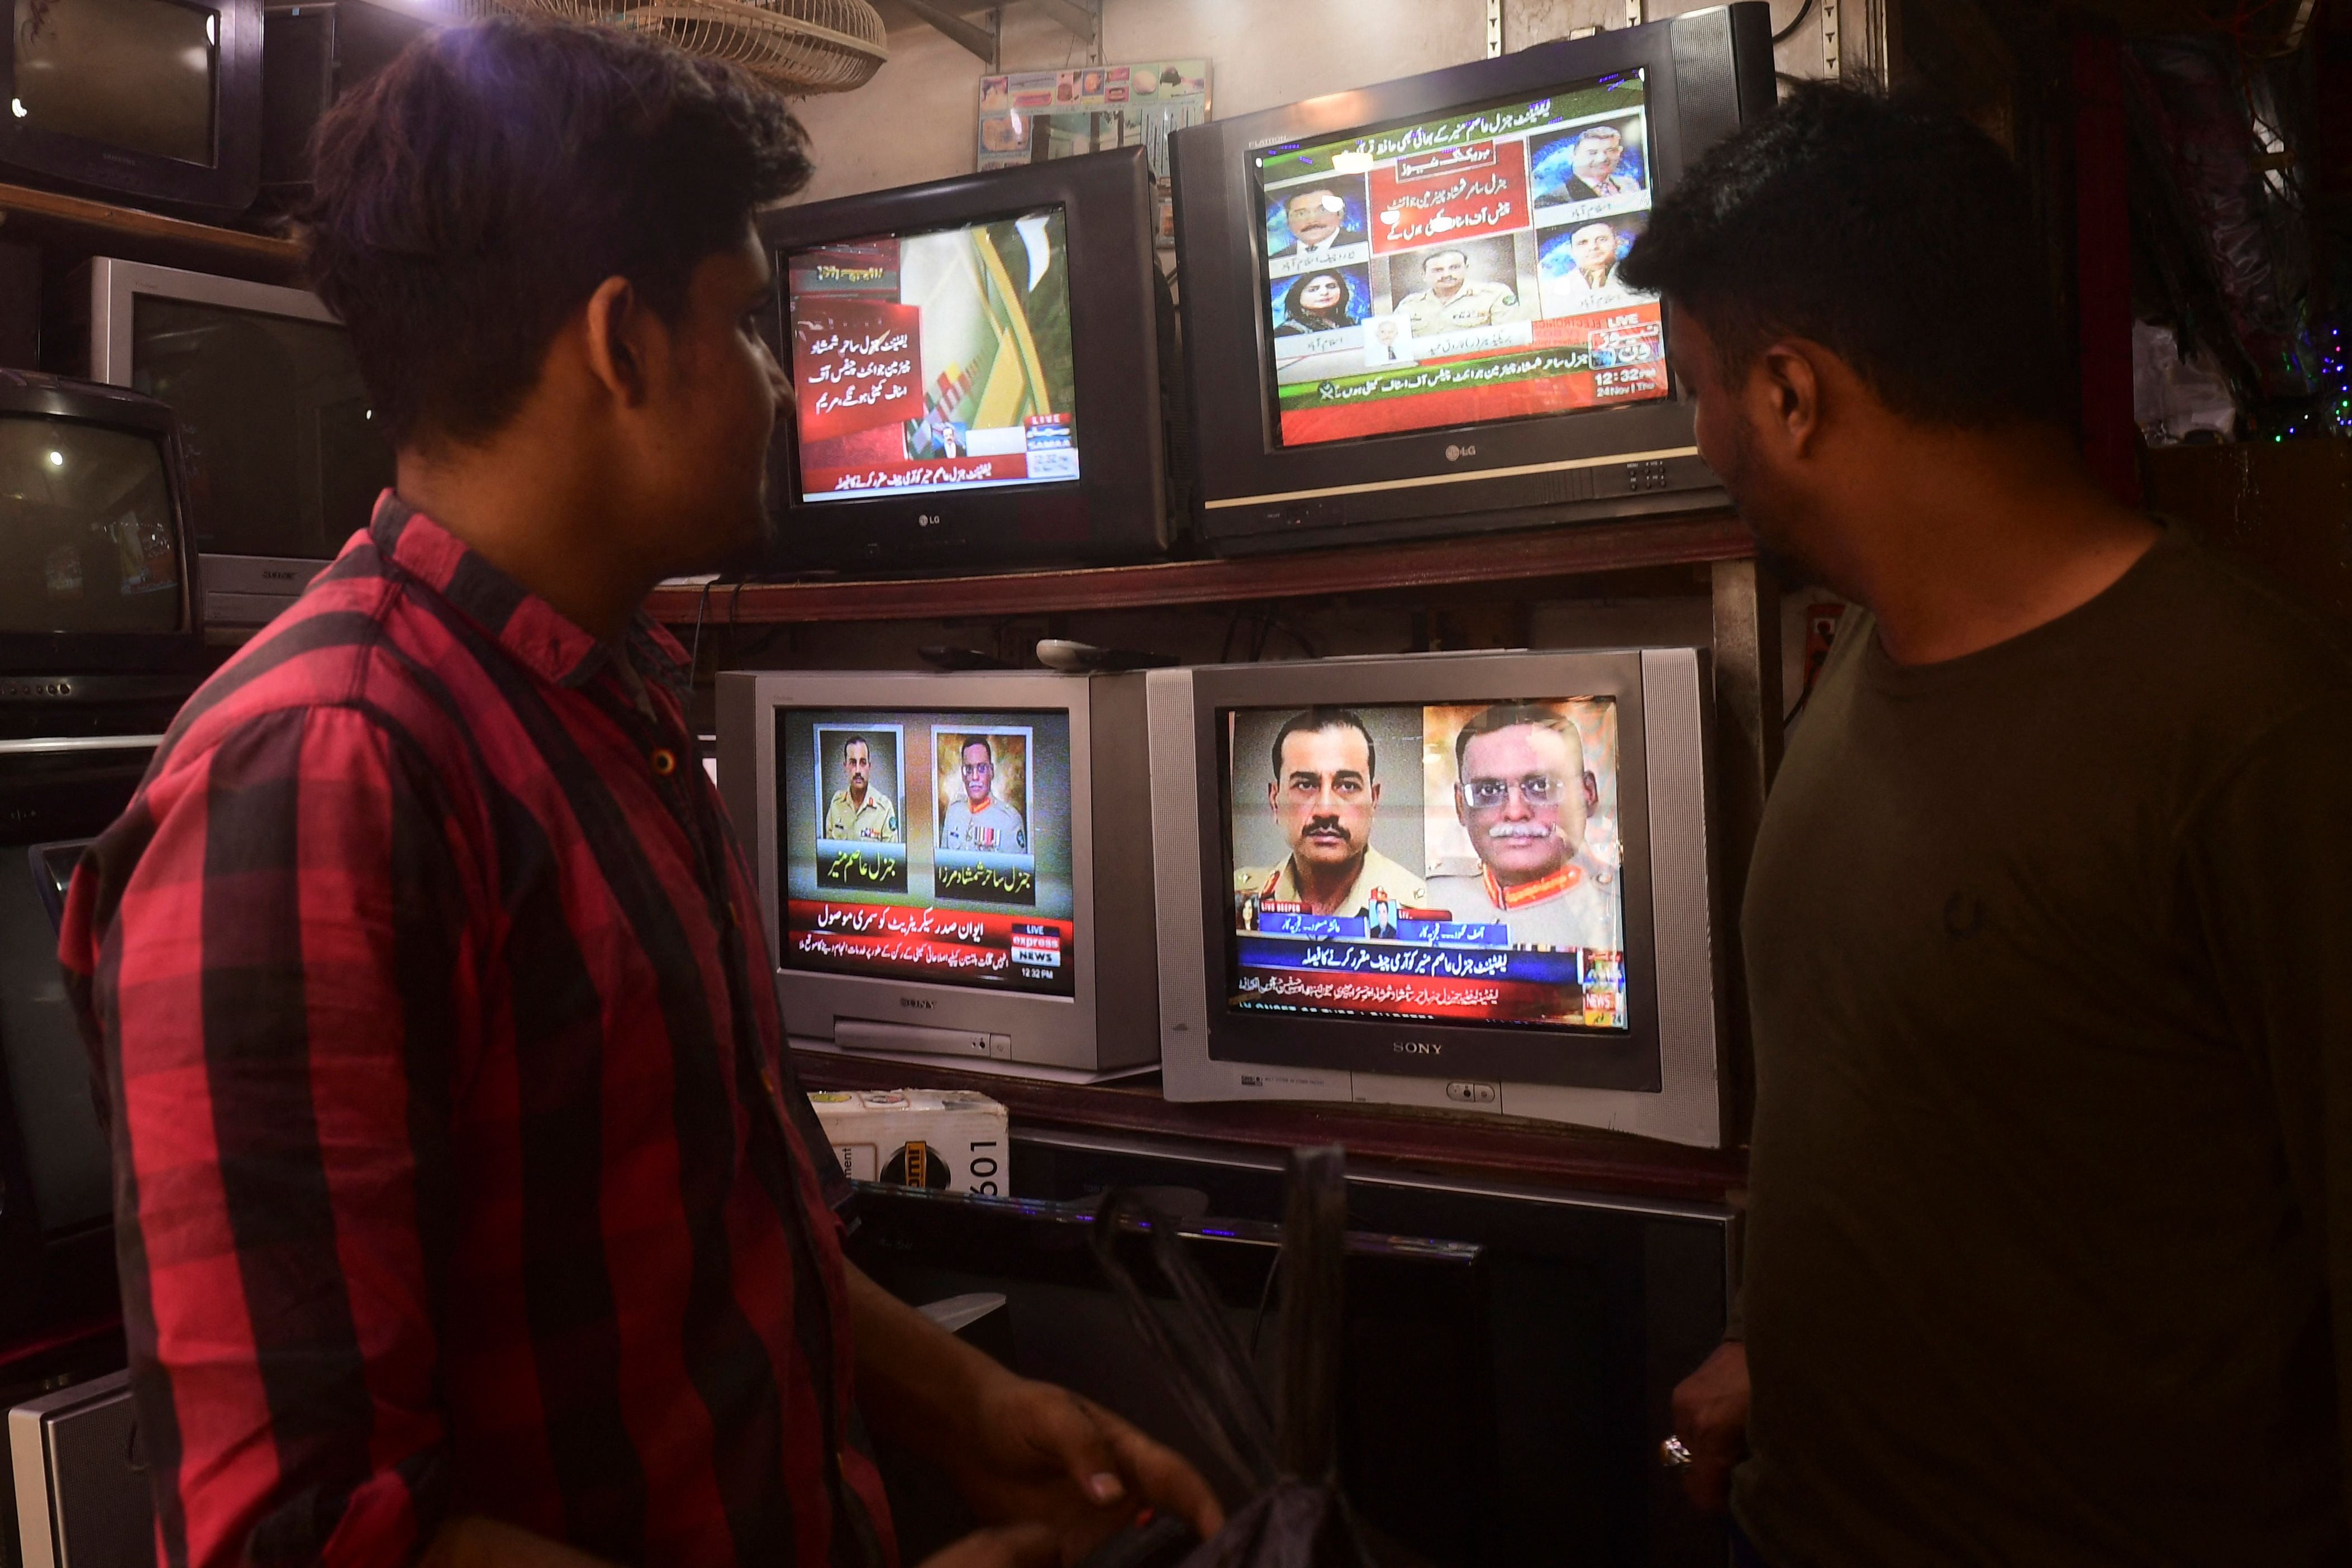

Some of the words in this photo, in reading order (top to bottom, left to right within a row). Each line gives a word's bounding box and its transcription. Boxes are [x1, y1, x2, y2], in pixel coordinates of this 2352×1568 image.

[1608, 313, 1639, 328] LIVE
[1461, 445, 1477, 457] LG
[929, 515, 941, 525] LG
[827, 850, 848, 879] منیر
[844, 849, 868, 884] عاصم
[869, 851, 896, 883] جنرل
[956, 860, 984, 886] شمشاد
[938, 866, 958, 889] مرزا
[981, 868, 1004, 888] ساحر
[1003, 864, 1031, 894] جنرل
[817, 903, 853, 928] موصول
[877, 905, 891, 930] کو
[934, 920, 957, 935] صدر
[957, 921, 984, 943] ایوان
[1026, 924, 1044, 935] LIVE
[1019, 950, 1053, 961] NEWS
[1452, 952, 1474, 977] جنرل
[1393, 1042, 1442, 1055] SONY
